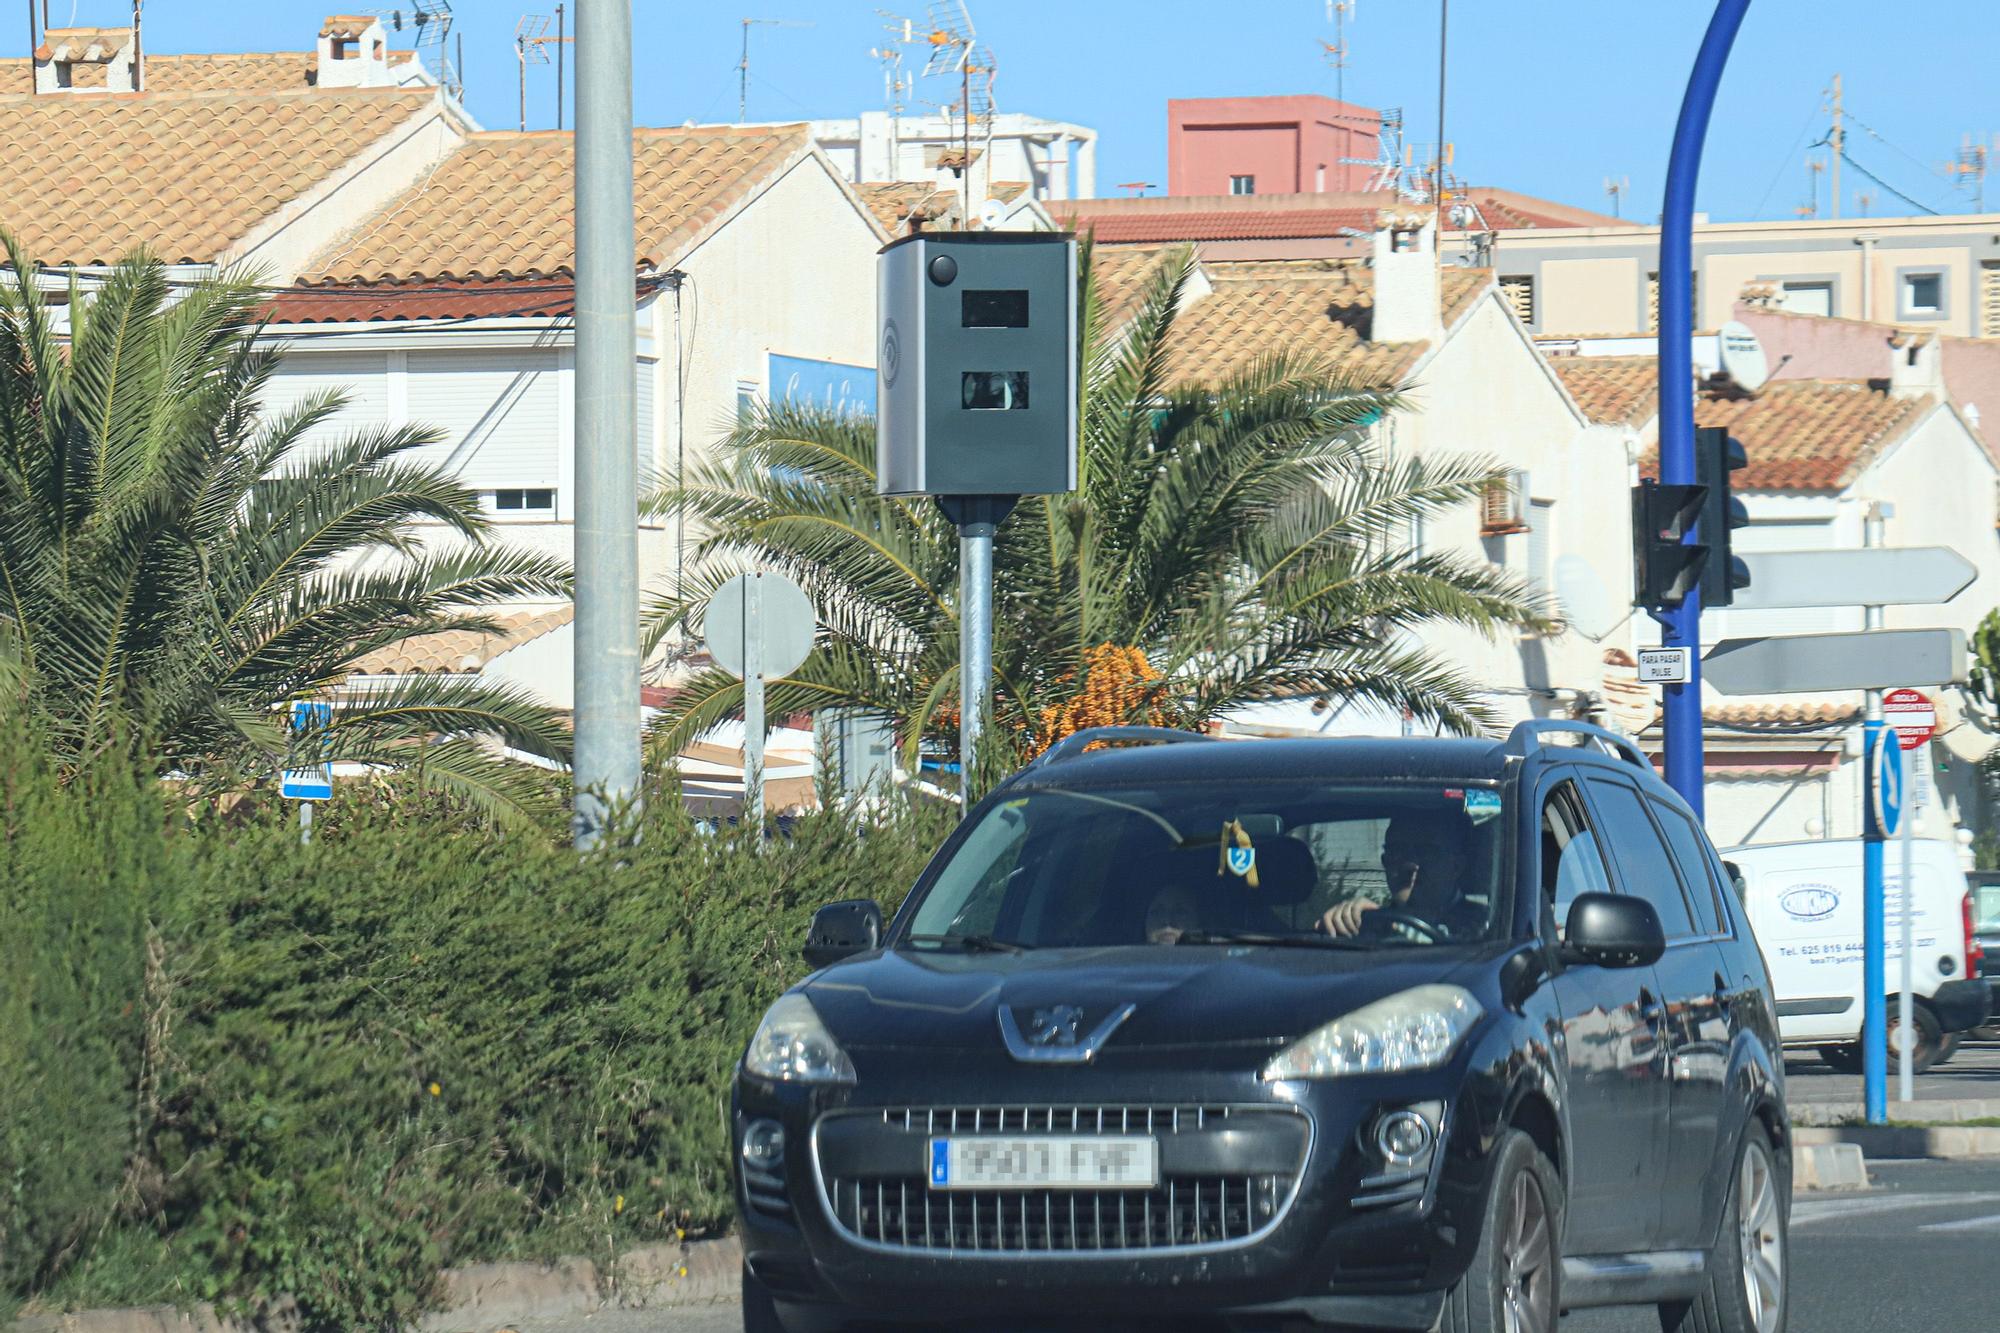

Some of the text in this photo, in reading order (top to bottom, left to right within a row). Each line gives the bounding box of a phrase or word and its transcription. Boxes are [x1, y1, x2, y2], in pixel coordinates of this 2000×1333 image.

[1660, 655, 1680, 663] PASAR
[1651, 668, 1671, 676] PULSE
[1235, 849, 1247, 867] 2
[1801, 945, 1819, 955] 625
[1823, 943, 1841, 953] 819
